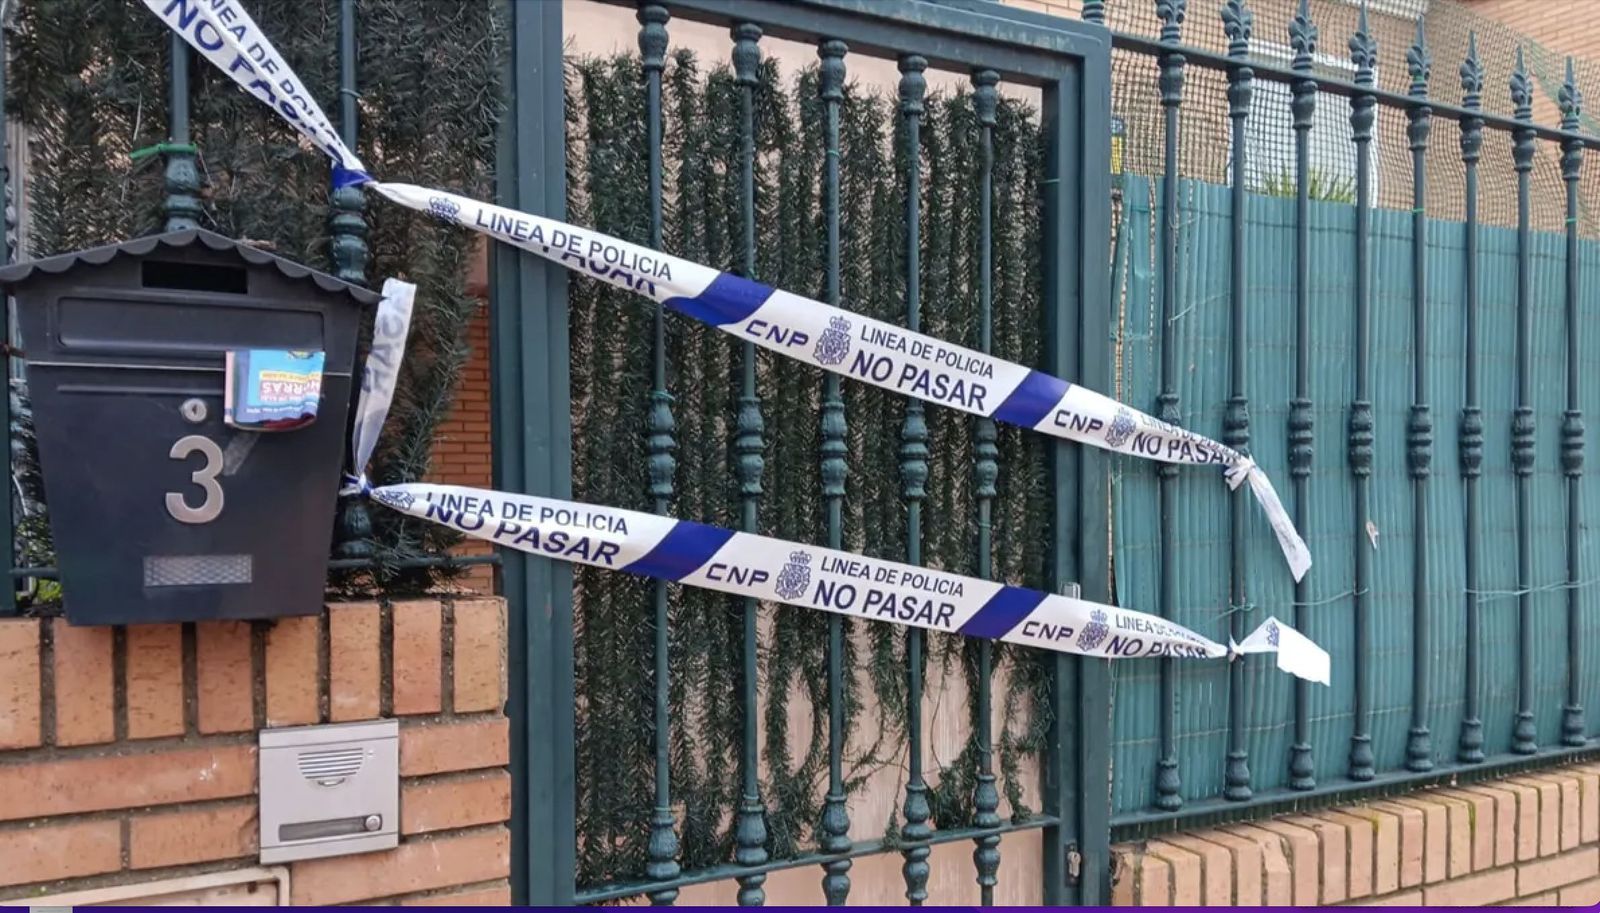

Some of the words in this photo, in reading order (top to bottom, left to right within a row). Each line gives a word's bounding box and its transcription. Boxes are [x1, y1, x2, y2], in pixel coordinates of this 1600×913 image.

[163, 0, 224, 51] NO
[211, 0, 247, 42] NEA
[476, 208, 544, 244] LINEA
[551, 229, 583, 254] DE
[588, 240, 673, 281] POLICIA
[745, 319, 809, 348] CNP
[860, 324, 907, 353] LINEA
[910, 339, 934, 361] DE
[935, 347, 995, 379] POLICIA
[850, 349, 894, 382] NO
[897, 363, 988, 412] PASAR
[1054, 409, 1104, 434] CNP
[1132, 431, 1164, 455] NO
[165, 434, 224, 524] 3
[425, 503, 485, 531] NO
[493, 520, 621, 566] PASAR
[502, 502, 535, 523] DE
[540, 506, 629, 536] POLICIA
[705, 563, 770, 588] CNP
[820, 555, 871, 581] LINEA
[874, 566, 899, 585] DE
[900, 571, 964, 598] POLICIA
[813, 579, 858, 610] NO
[862, 589, 956, 628] PASAR
[1115, 614, 1153, 634] LINEA
[1021, 620, 1075, 642] CNP
[1105, 636, 1143, 656] NO
